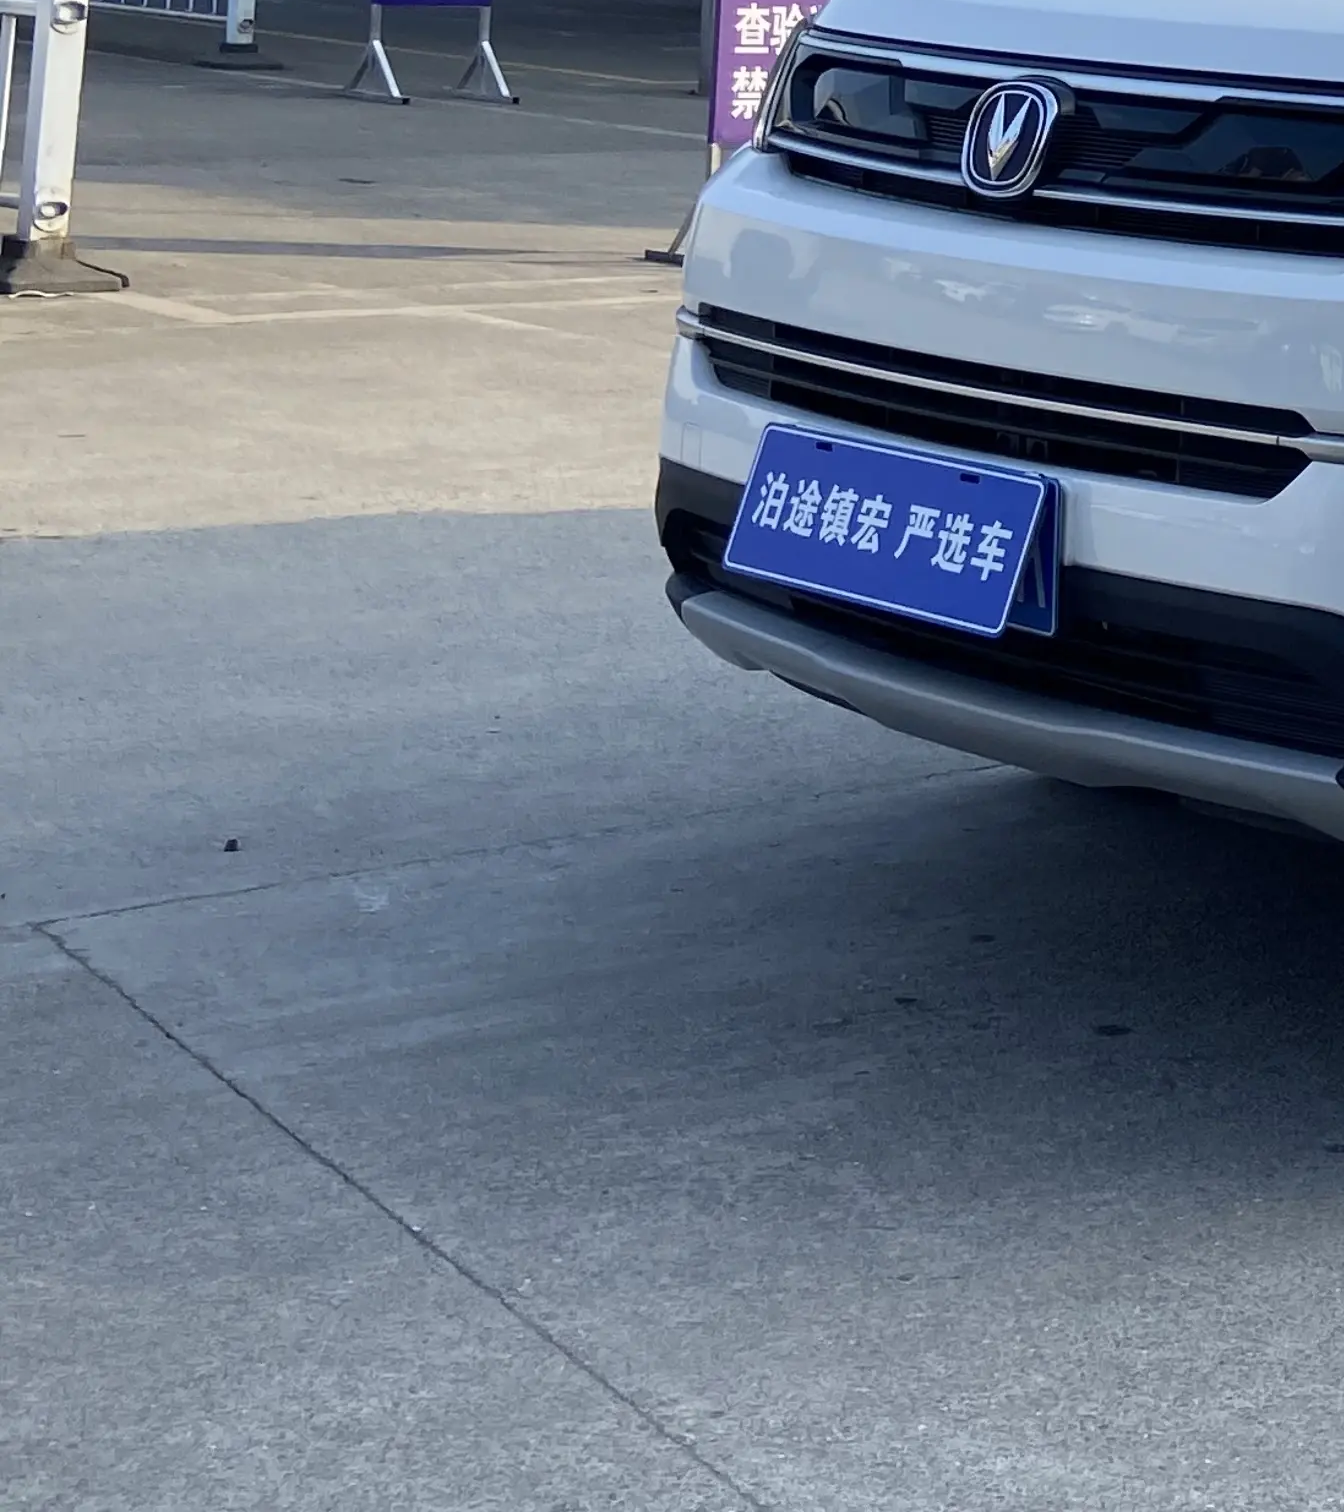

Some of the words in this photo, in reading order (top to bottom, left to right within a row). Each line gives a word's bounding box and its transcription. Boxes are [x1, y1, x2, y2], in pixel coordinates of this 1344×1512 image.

[751, 471, 894, 555] 泊途镇宏
[893, 503, 1014, 582] 严选车
